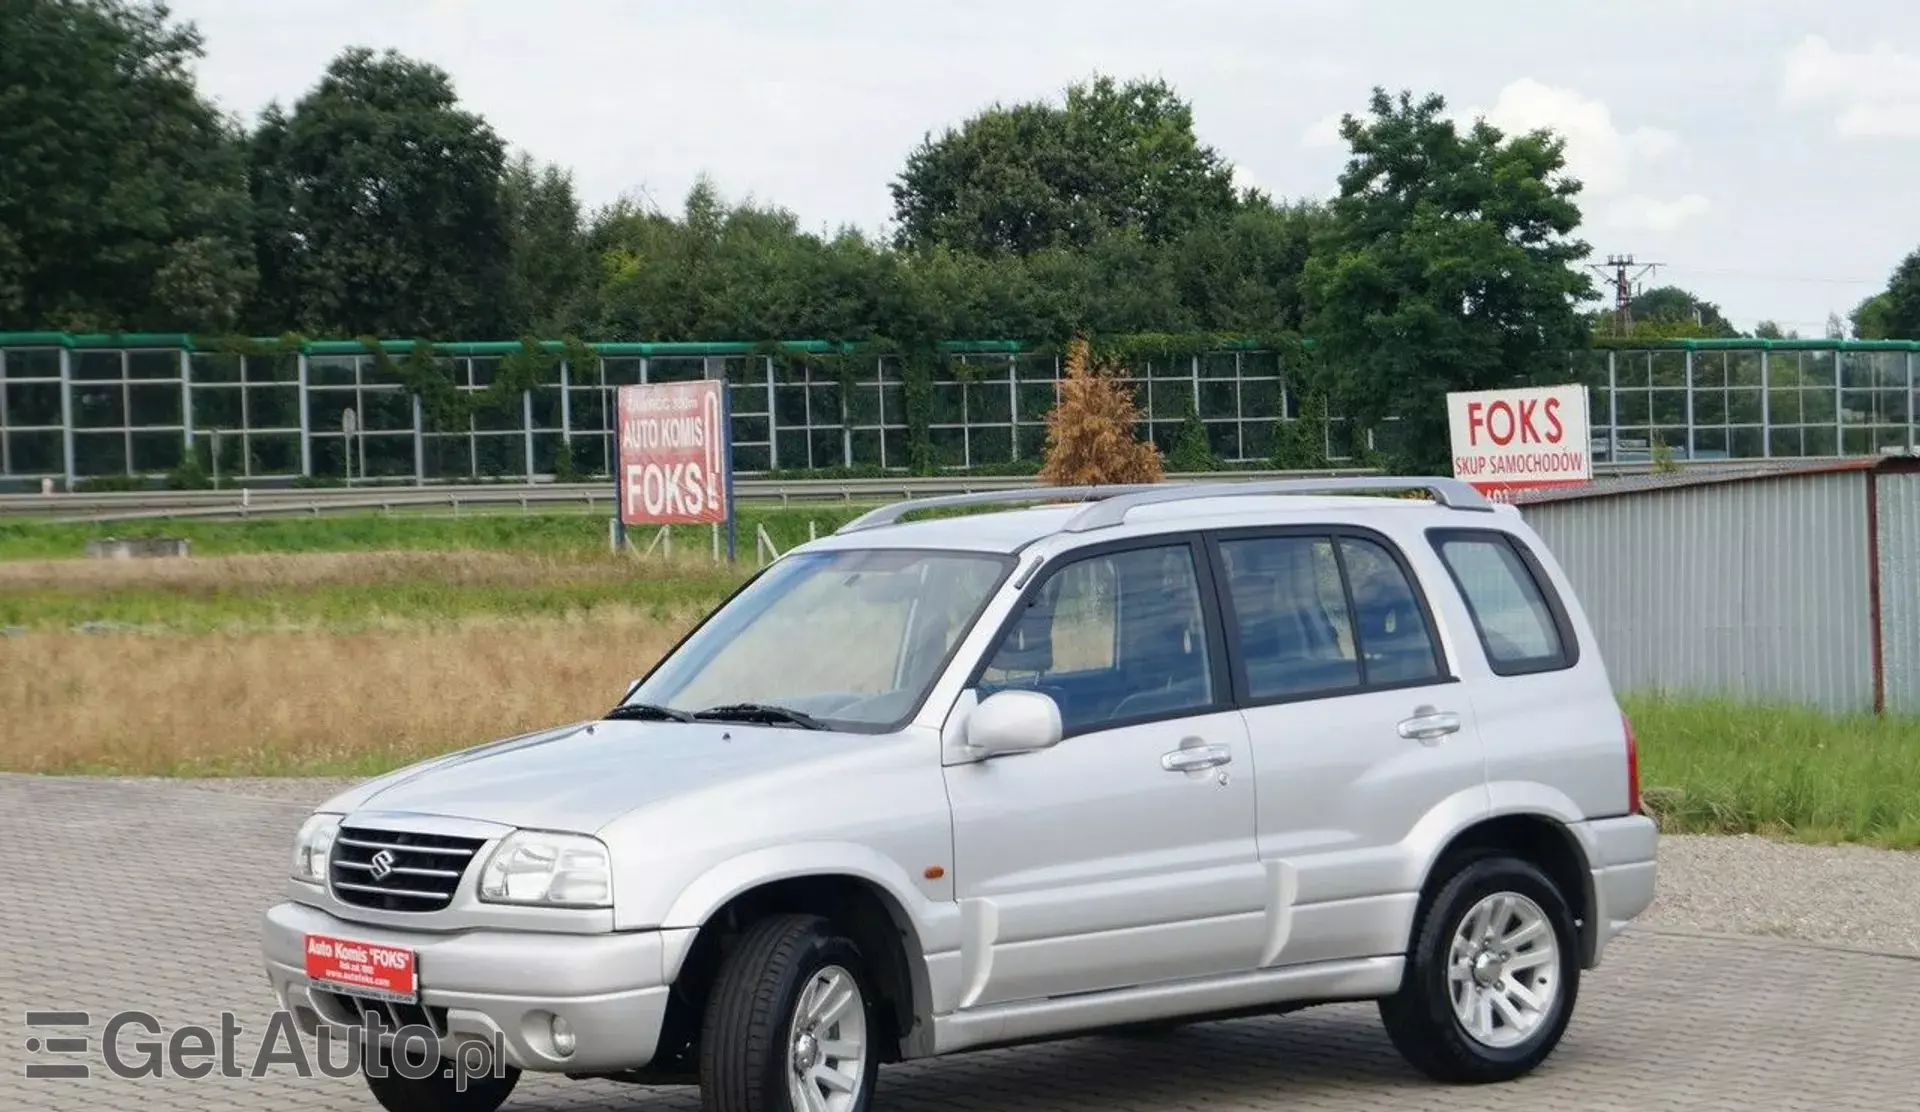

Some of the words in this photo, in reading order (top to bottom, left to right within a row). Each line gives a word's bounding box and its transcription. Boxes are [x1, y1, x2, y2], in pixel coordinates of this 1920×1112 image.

[624, 421, 657, 448] AUTO
[661, 417, 703, 447] KOMIS
[1467, 397, 1562, 446] FOKS
[1456, 457, 1486, 475] SKUP
[1490, 450, 1582, 474] SAMOCHODÓW
[628, 463, 703, 515] FOKS
[308, 938, 332, 957] Auto
[334, 942, 368, 963] Komis
